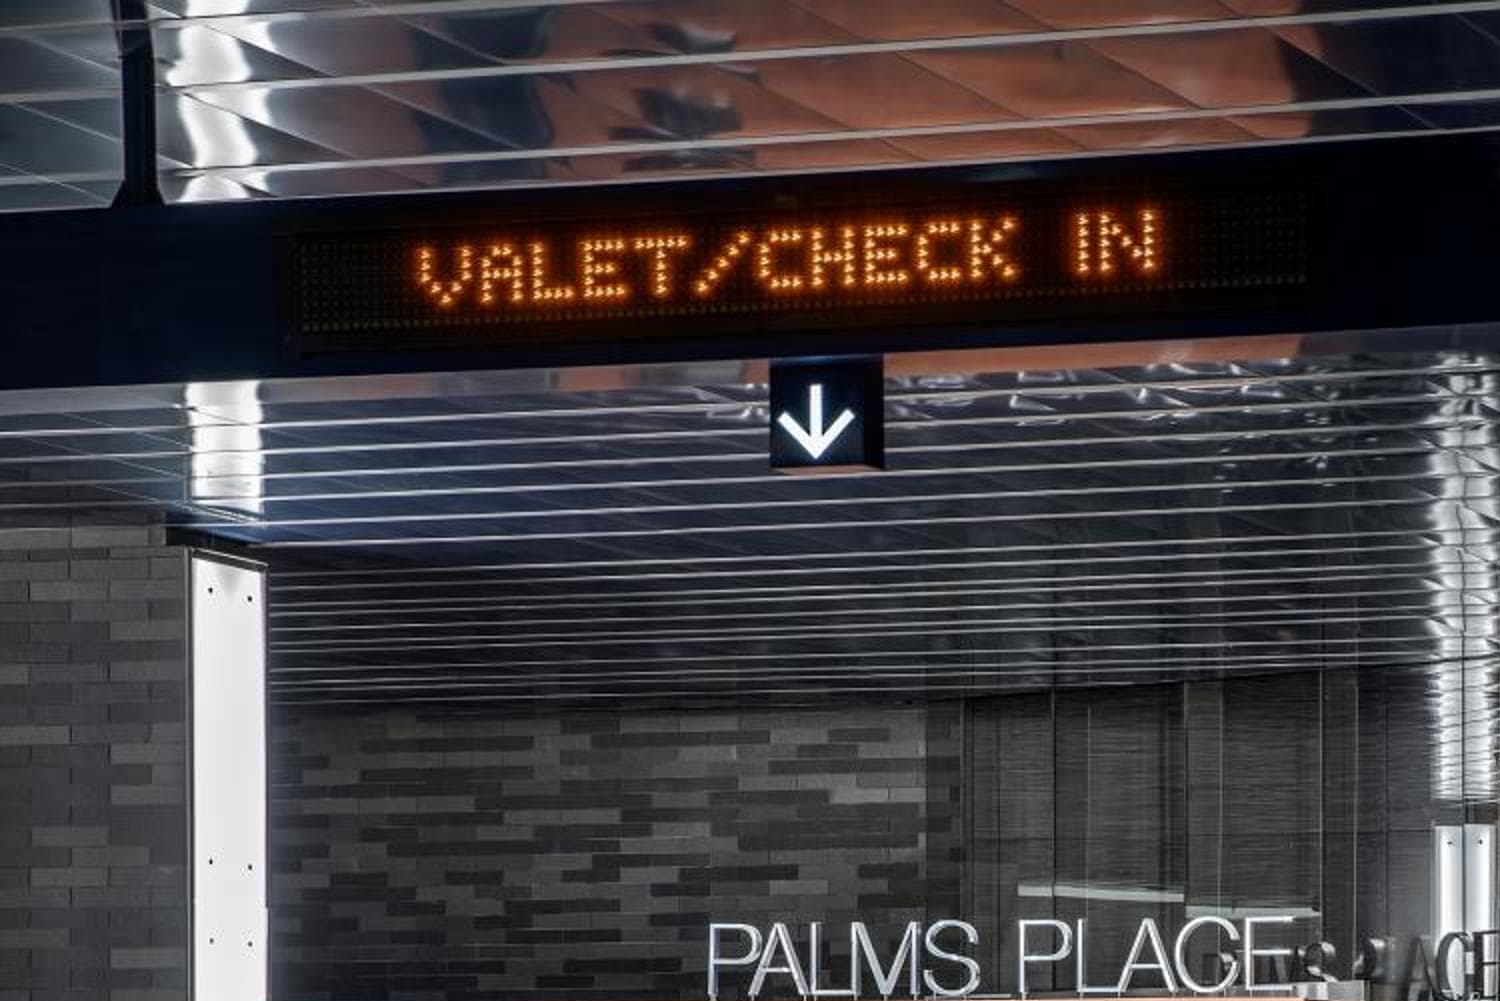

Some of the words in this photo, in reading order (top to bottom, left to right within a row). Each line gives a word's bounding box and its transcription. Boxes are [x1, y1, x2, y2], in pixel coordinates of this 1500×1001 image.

[419, 216, 1020, 306] VALET/CHECK
[1075, 210, 1157, 274] IN
[707, 919, 981, 1001] PALMS
[1018, 915, 1295, 998] PLACE
